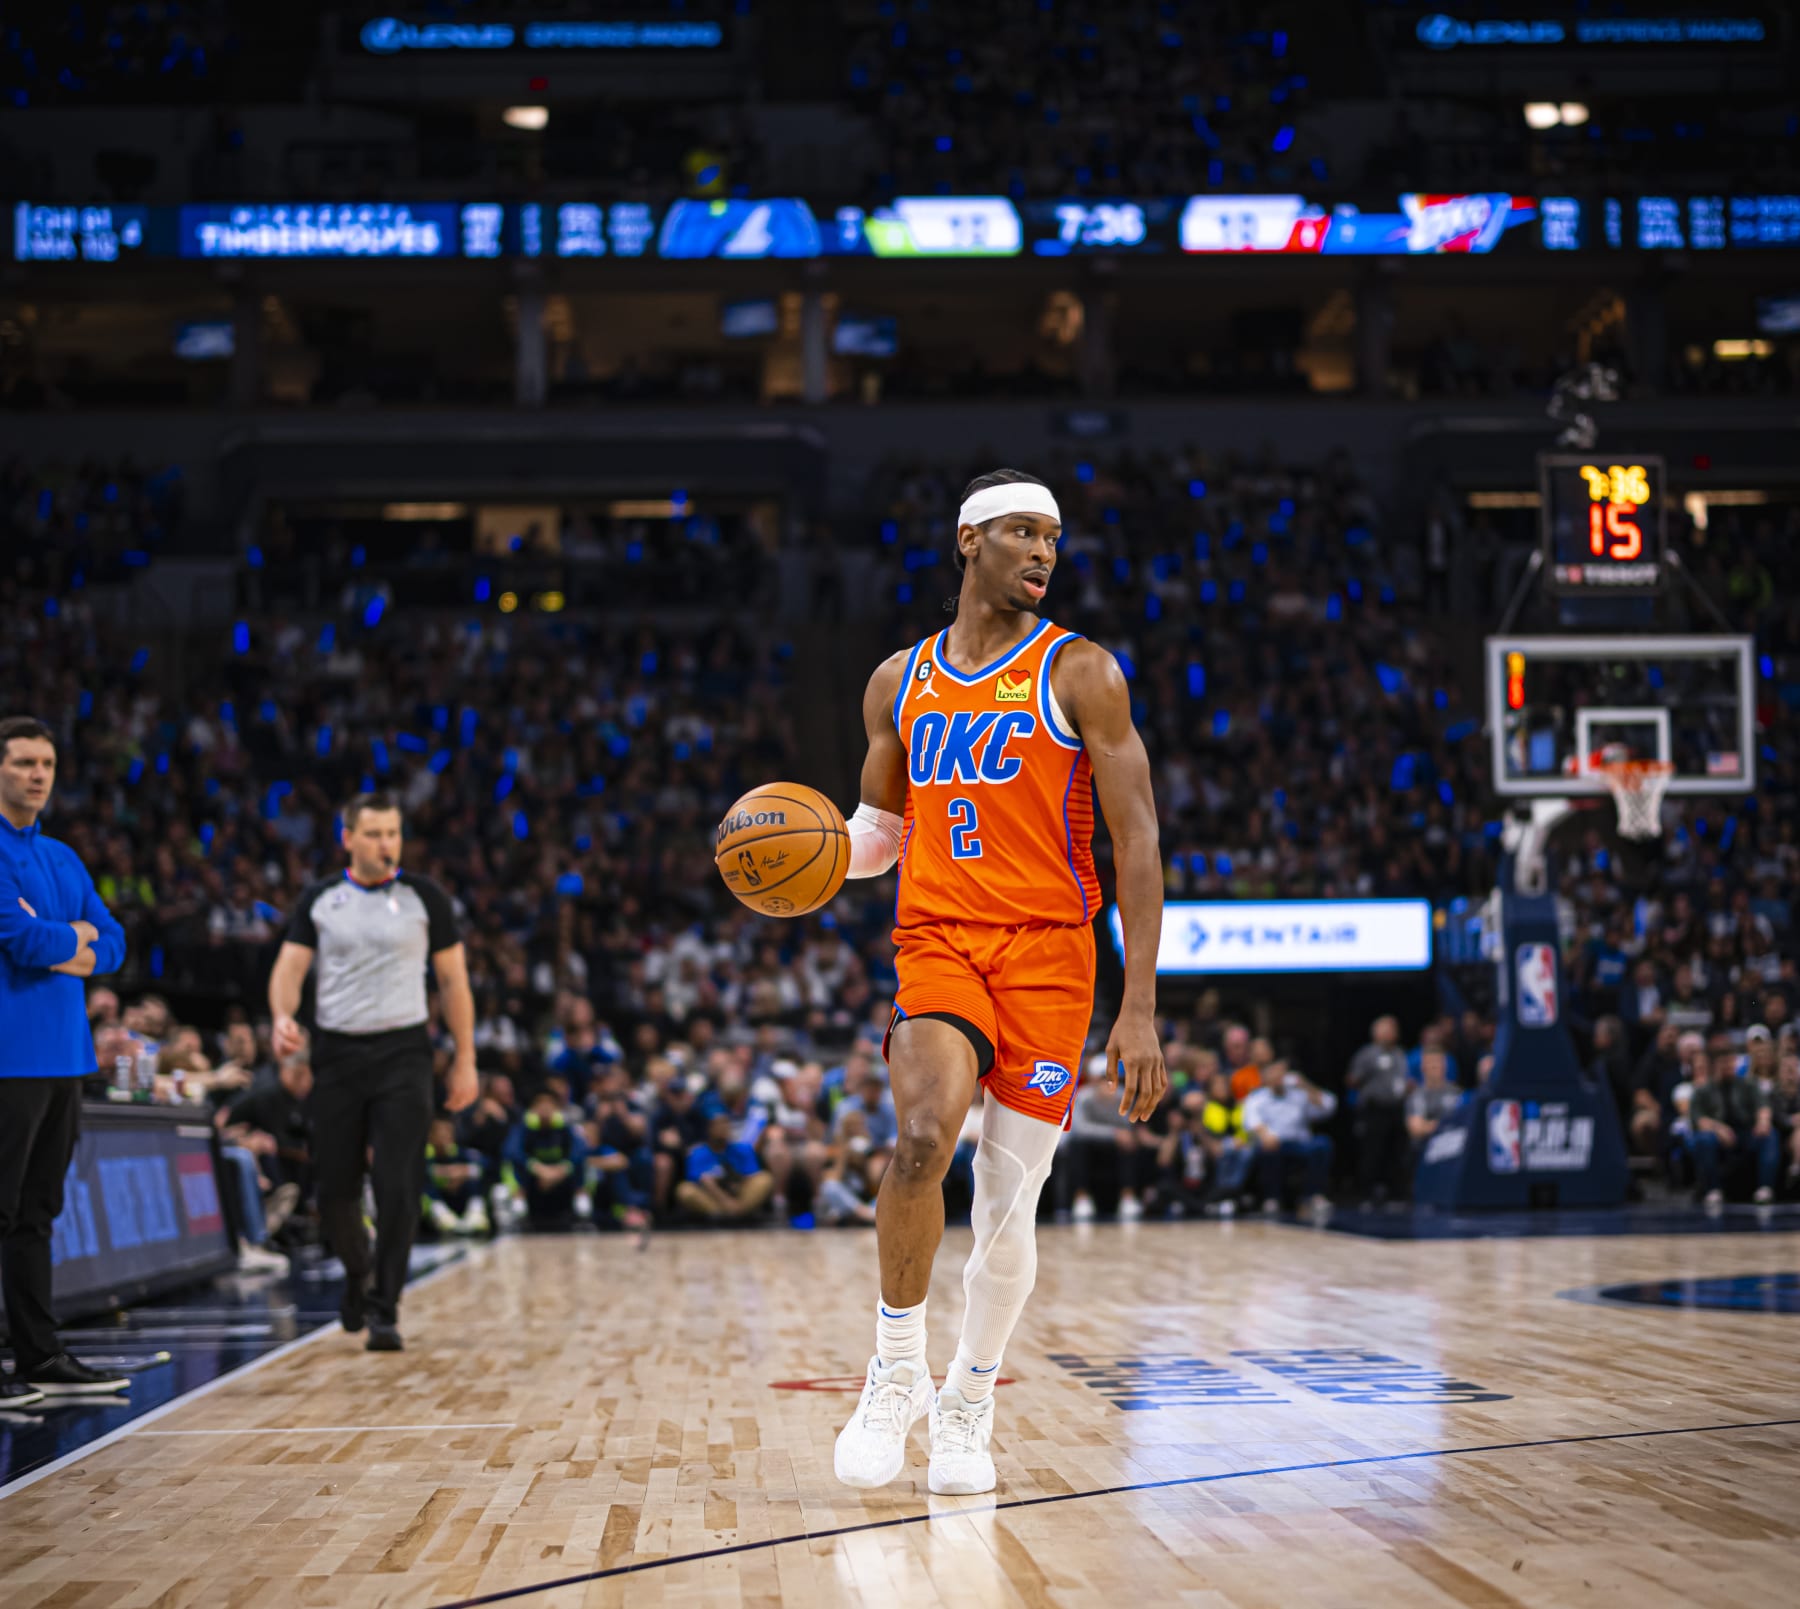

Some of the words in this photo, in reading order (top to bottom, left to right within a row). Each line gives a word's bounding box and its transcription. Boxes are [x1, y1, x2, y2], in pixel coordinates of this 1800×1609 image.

[1580, 465, 1650, 504] 7:36
[1590, 502, 1642, 560] 15
[918, 663, 930, 681] 6
[910, 710, 1036, 787] OKC
[948, 797, 983, 859] 2
[1219, 923, 1358, 947] PENTAIR
[1228, 1347, 1515, 1405] CENTER
